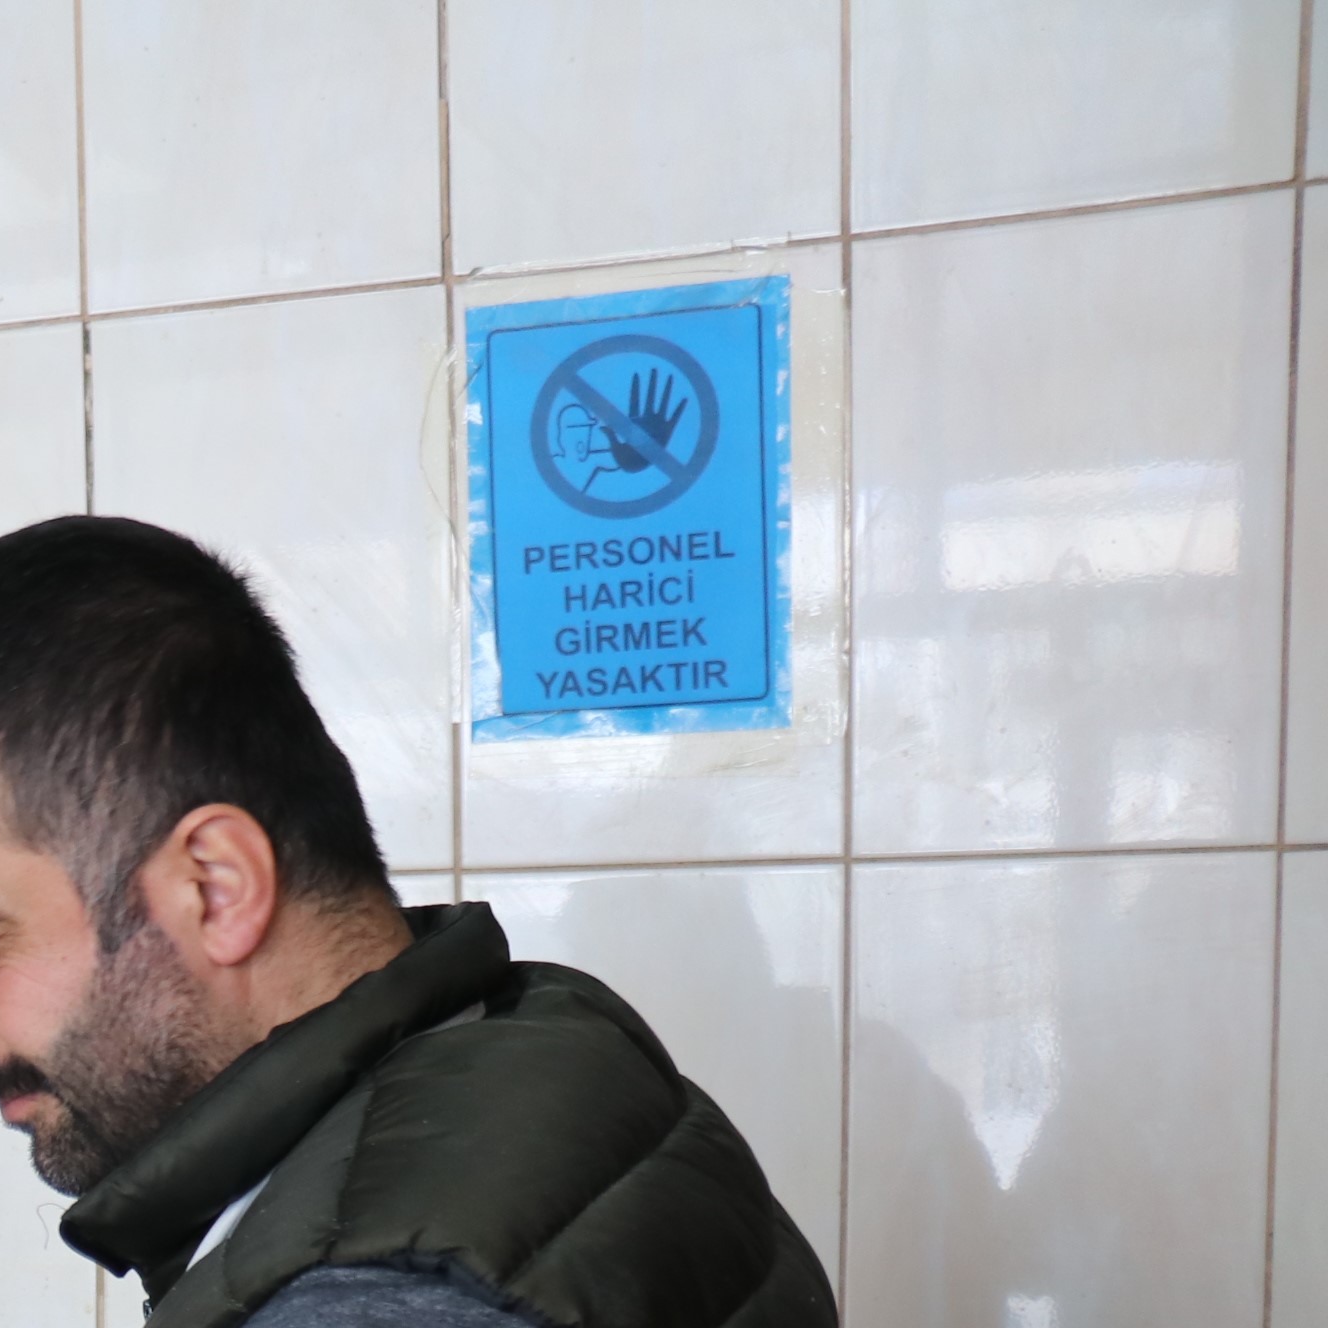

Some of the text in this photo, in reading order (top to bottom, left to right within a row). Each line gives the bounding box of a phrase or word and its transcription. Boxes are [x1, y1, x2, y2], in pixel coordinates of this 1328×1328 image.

[523, 531, 736, 575] PERSONEL
[564, 569, 694, 613] HARİCİ
[555, 617, 707, 656] GİRMEK
[536, 660, 728, 699] YASAKTIR
